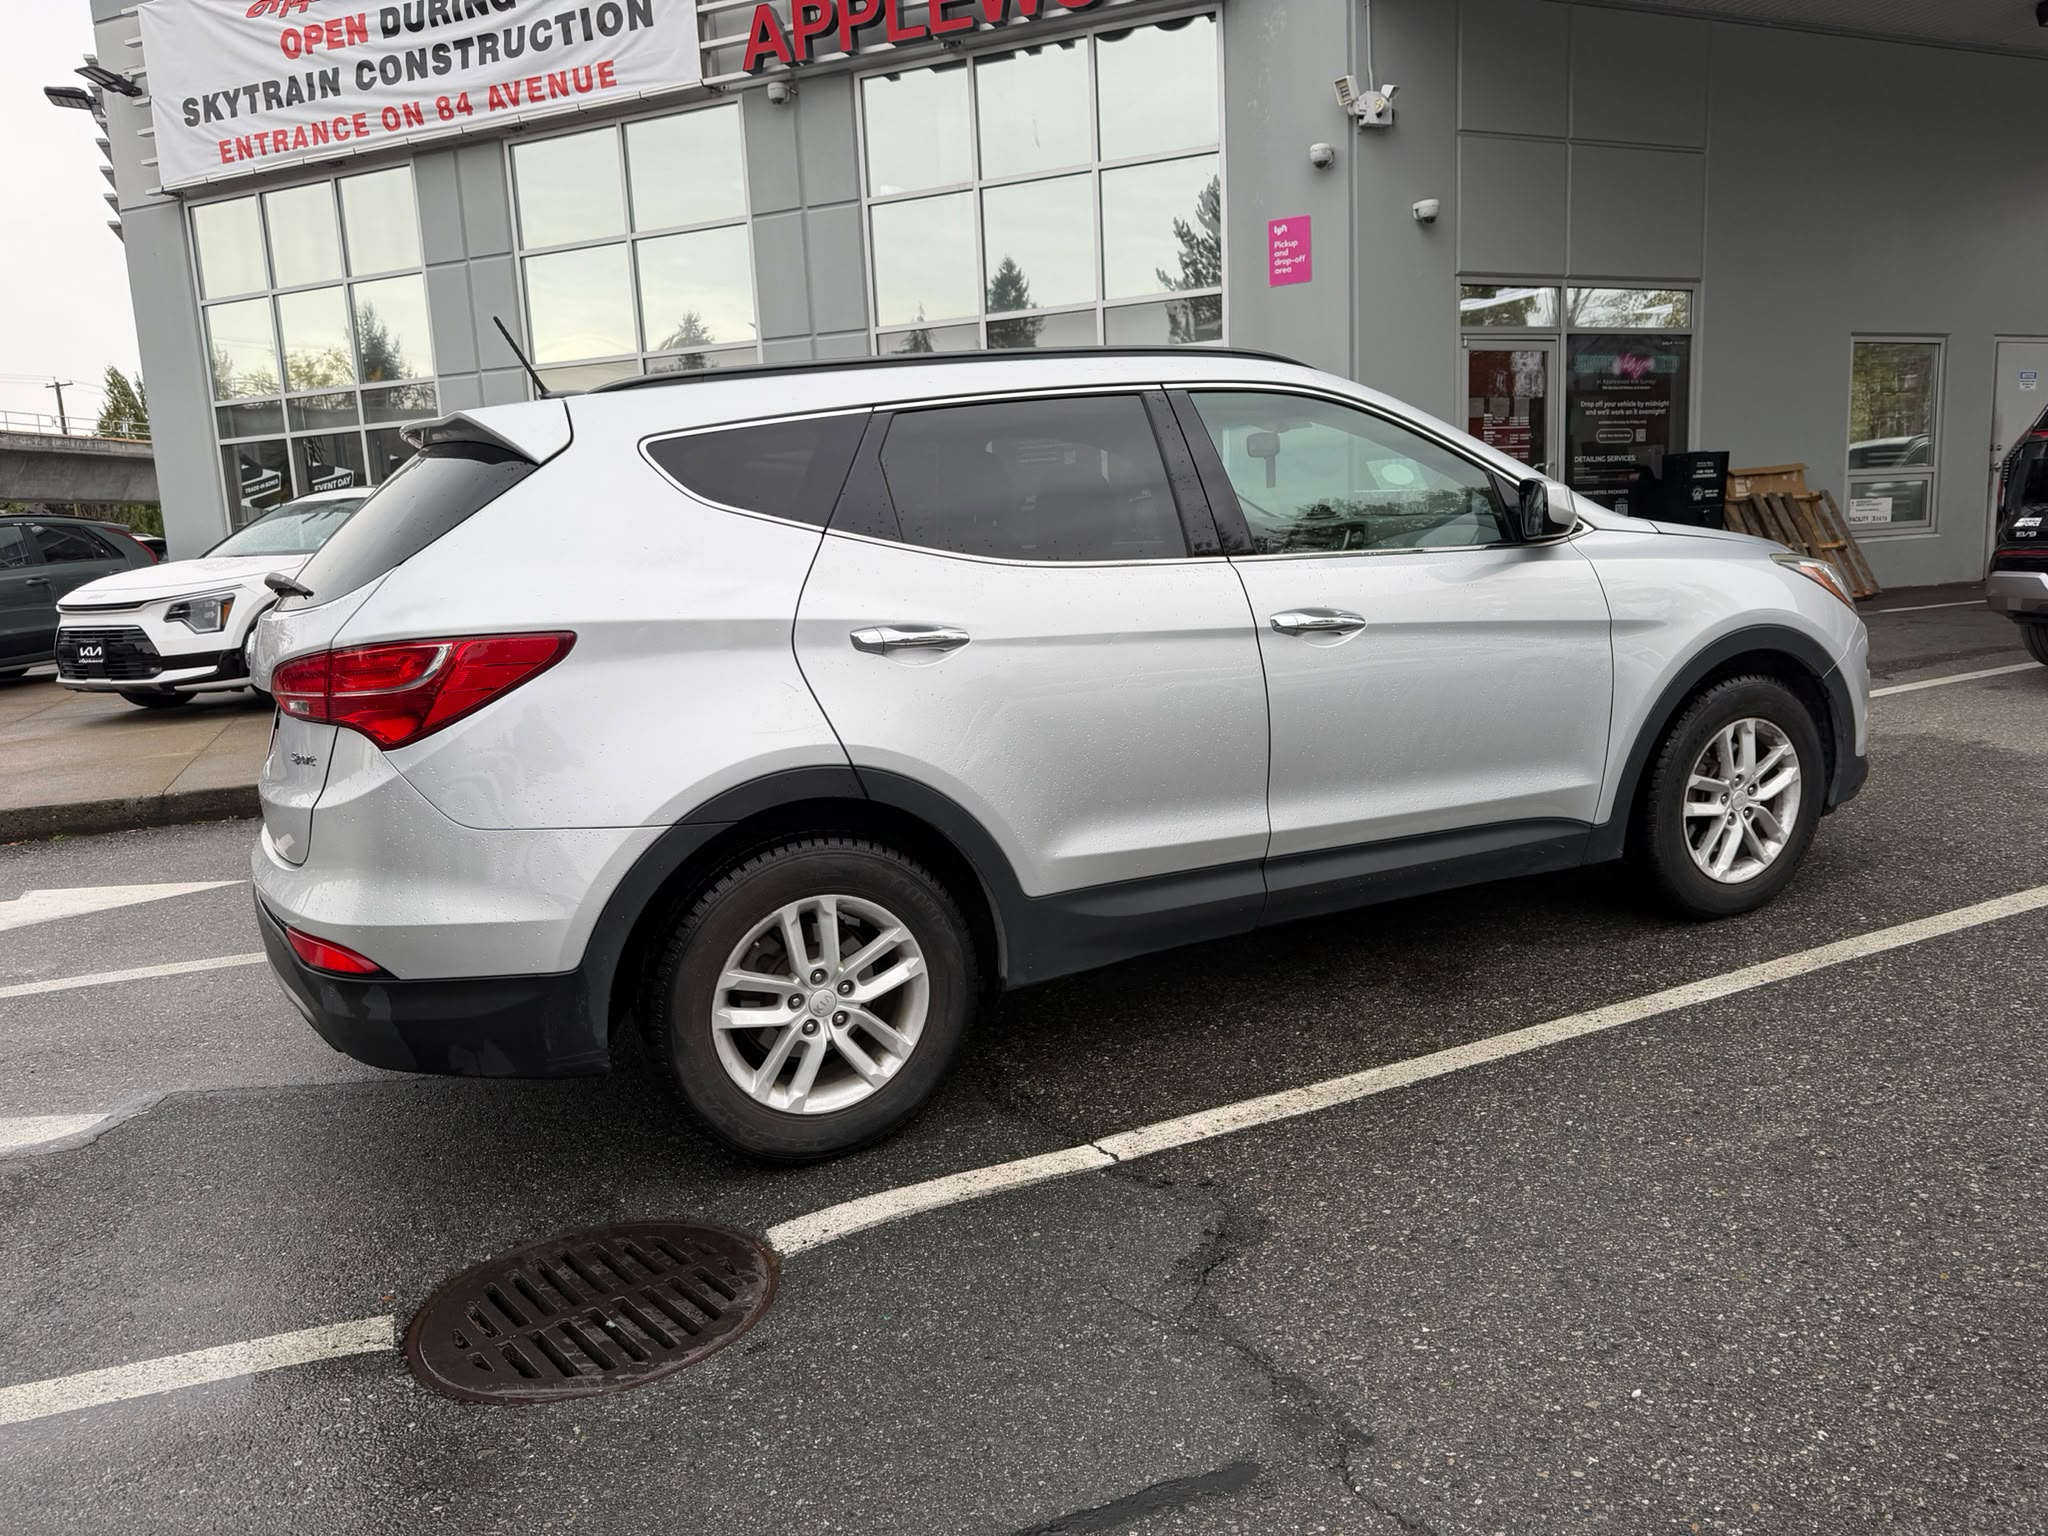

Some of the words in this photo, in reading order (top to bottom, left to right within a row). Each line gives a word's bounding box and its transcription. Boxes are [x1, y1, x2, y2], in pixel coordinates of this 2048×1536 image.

[280, 13, 369, 59] OPEN
[182, 67, 341, 127] SKYTRAIN
[355, 0, 654, 91] CONSTRUCTION
[218, 113, 370, 164] ENTRANCE
[381, 101, 425, 132] ON
[435, 91, 474, 121] 84
[488, 59, 618, 112] AVENUE
[1274, 224, 1288, 236] lyft
[1274, 240, 1298, 248] Pickup
[1274, 248, 1288, 257] and
[1274, 254, 1306, 266] drop-off
[1645, 400, 1670, 408] midnight
[1638, 408, 1666, 416] overnight!
[1574, 455, 1606, 463] DETAILING
[314, 481, 337, 491] EVENT
[338, 476, 351, 488] DAY
[80, 646, 102, 656] KIA
[813, 995, 833, 1014] KIA
